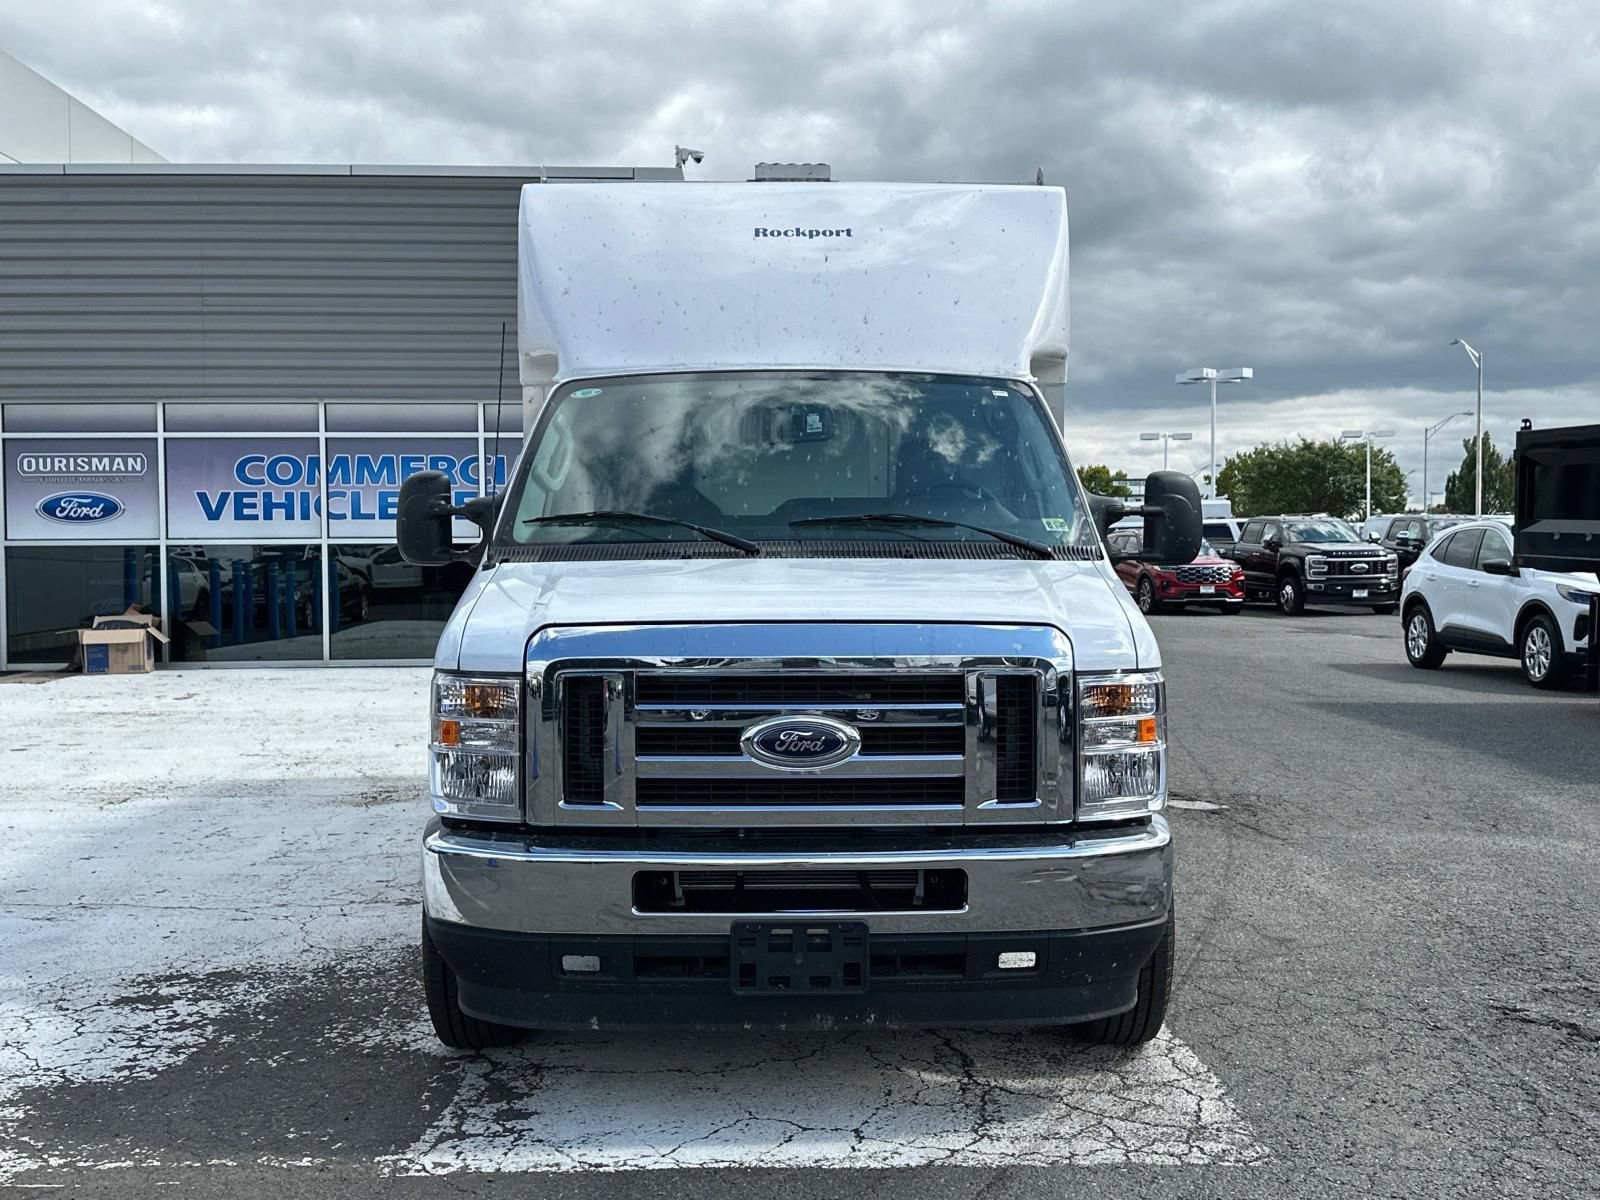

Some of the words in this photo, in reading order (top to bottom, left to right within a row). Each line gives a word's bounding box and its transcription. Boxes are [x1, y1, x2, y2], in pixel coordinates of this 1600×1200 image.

[754, 227, 853, 239] Rockport
[22, 456, 142, 472] OURISMAN
[234, 454, 515, 487] COMMERCI
[55, 497, 105, 518] Ford
[194, 489, 400, 522] VEHICLE
[774, 730, 826, 752] Ford
